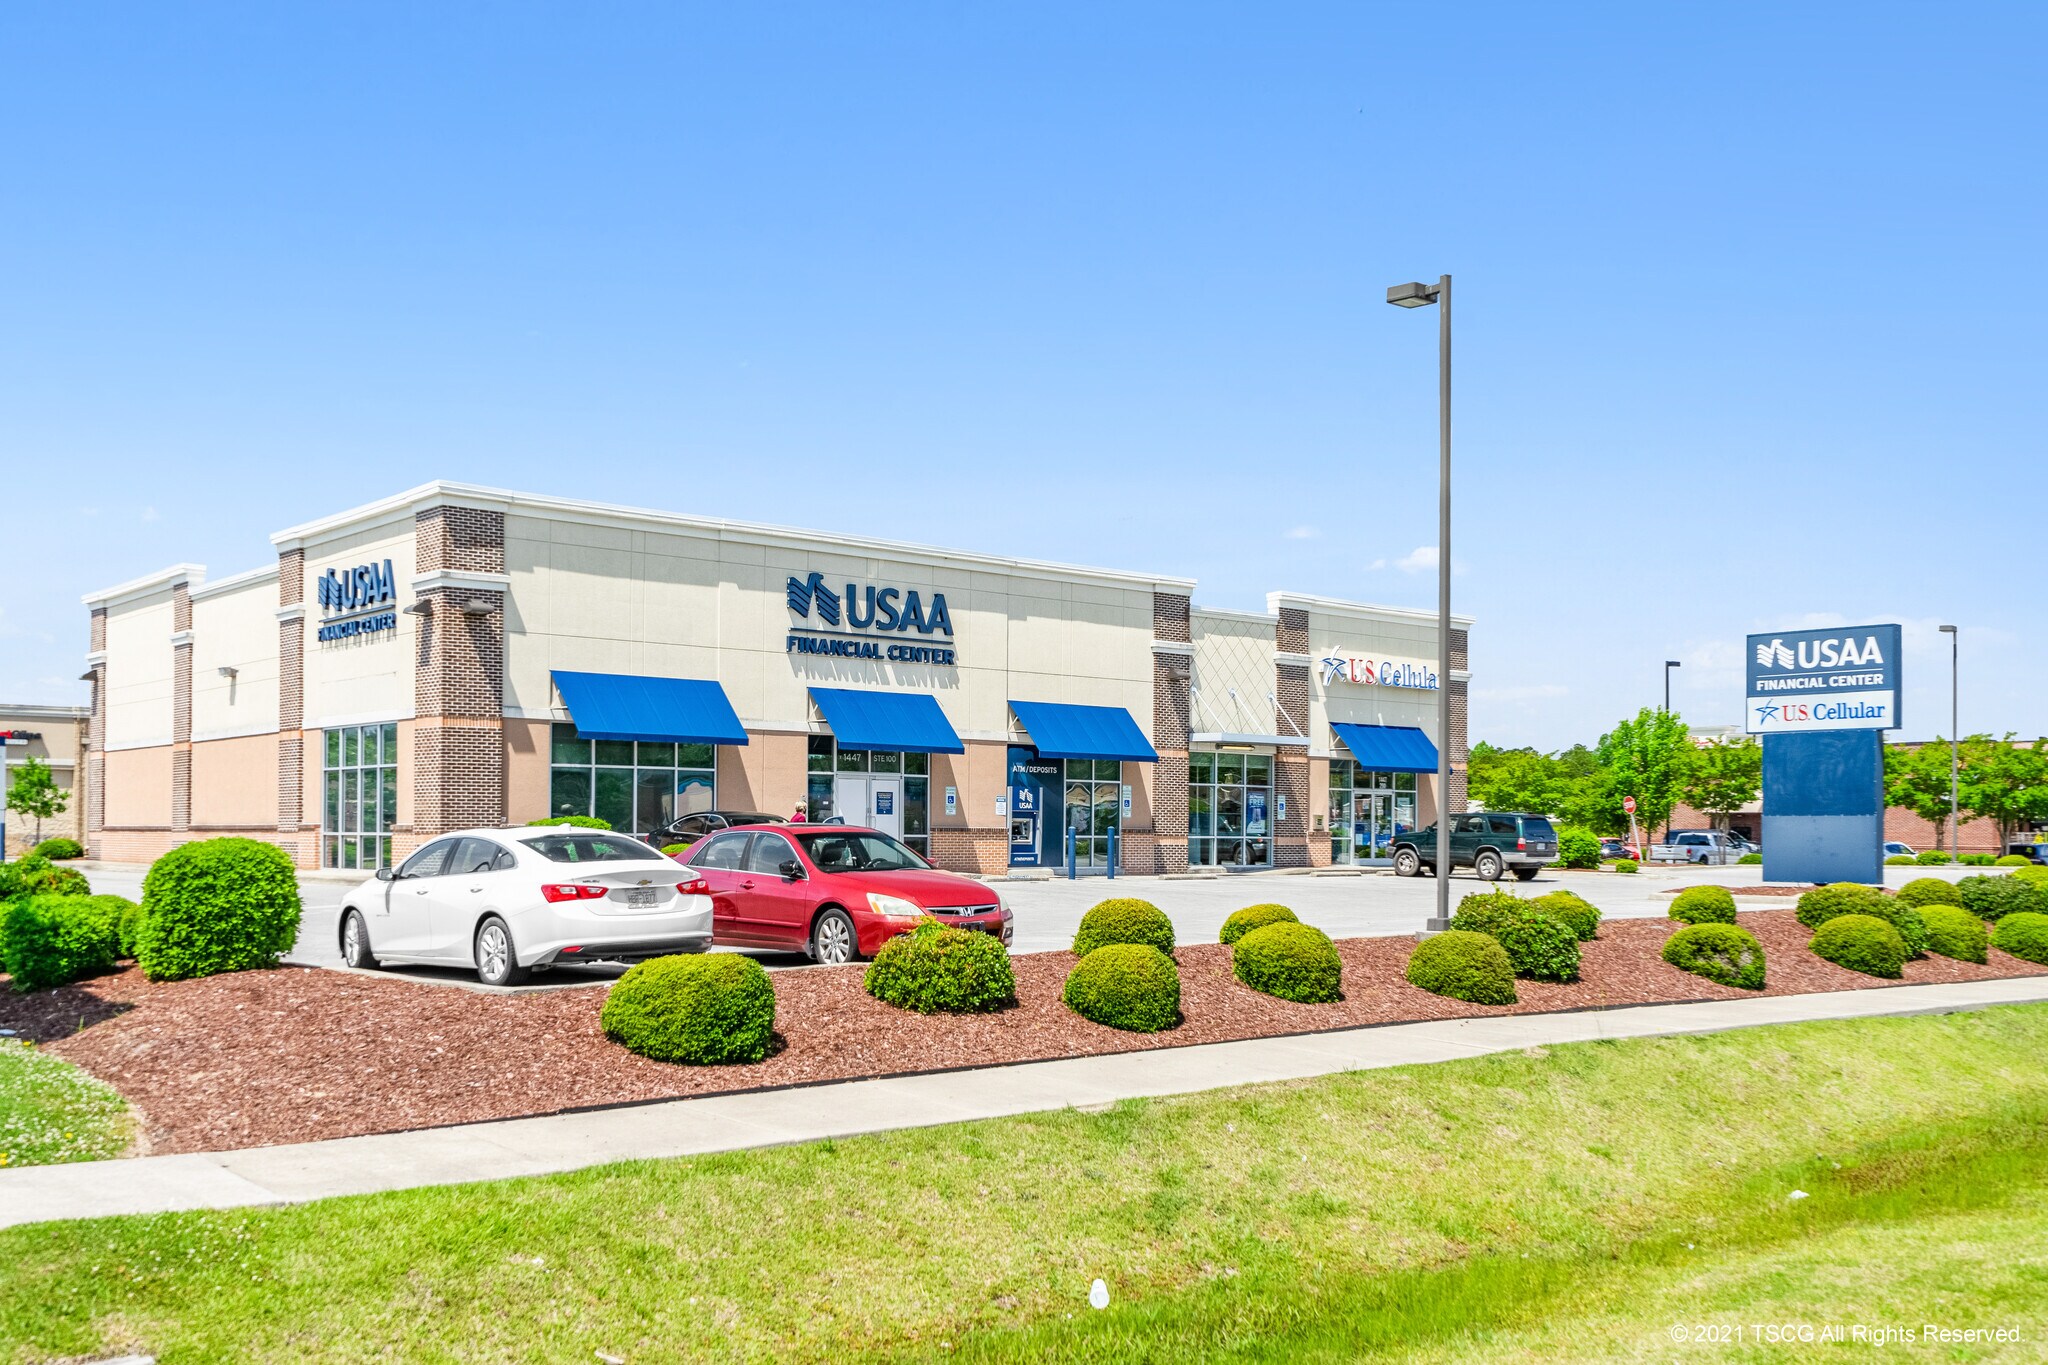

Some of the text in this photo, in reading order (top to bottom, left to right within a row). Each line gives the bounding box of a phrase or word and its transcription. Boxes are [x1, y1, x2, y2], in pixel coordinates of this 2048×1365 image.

[342, 559, 397, 610] USAA
[846, 583, 954, 636] USAA
[318, 613, 397, 642] FINANCIAL CENTER
[786, 635, 955, 666] FINANCIAL CENTER
[1798, 636, 1884, 669] USAA
[1380, 661, 1440, 690] Cellula
[1756, 673, 1884, 691] FINANCIAL CENTER
[1814, 702, 1885, 720] Cellular
[843, 753, 862, 762] 1447
